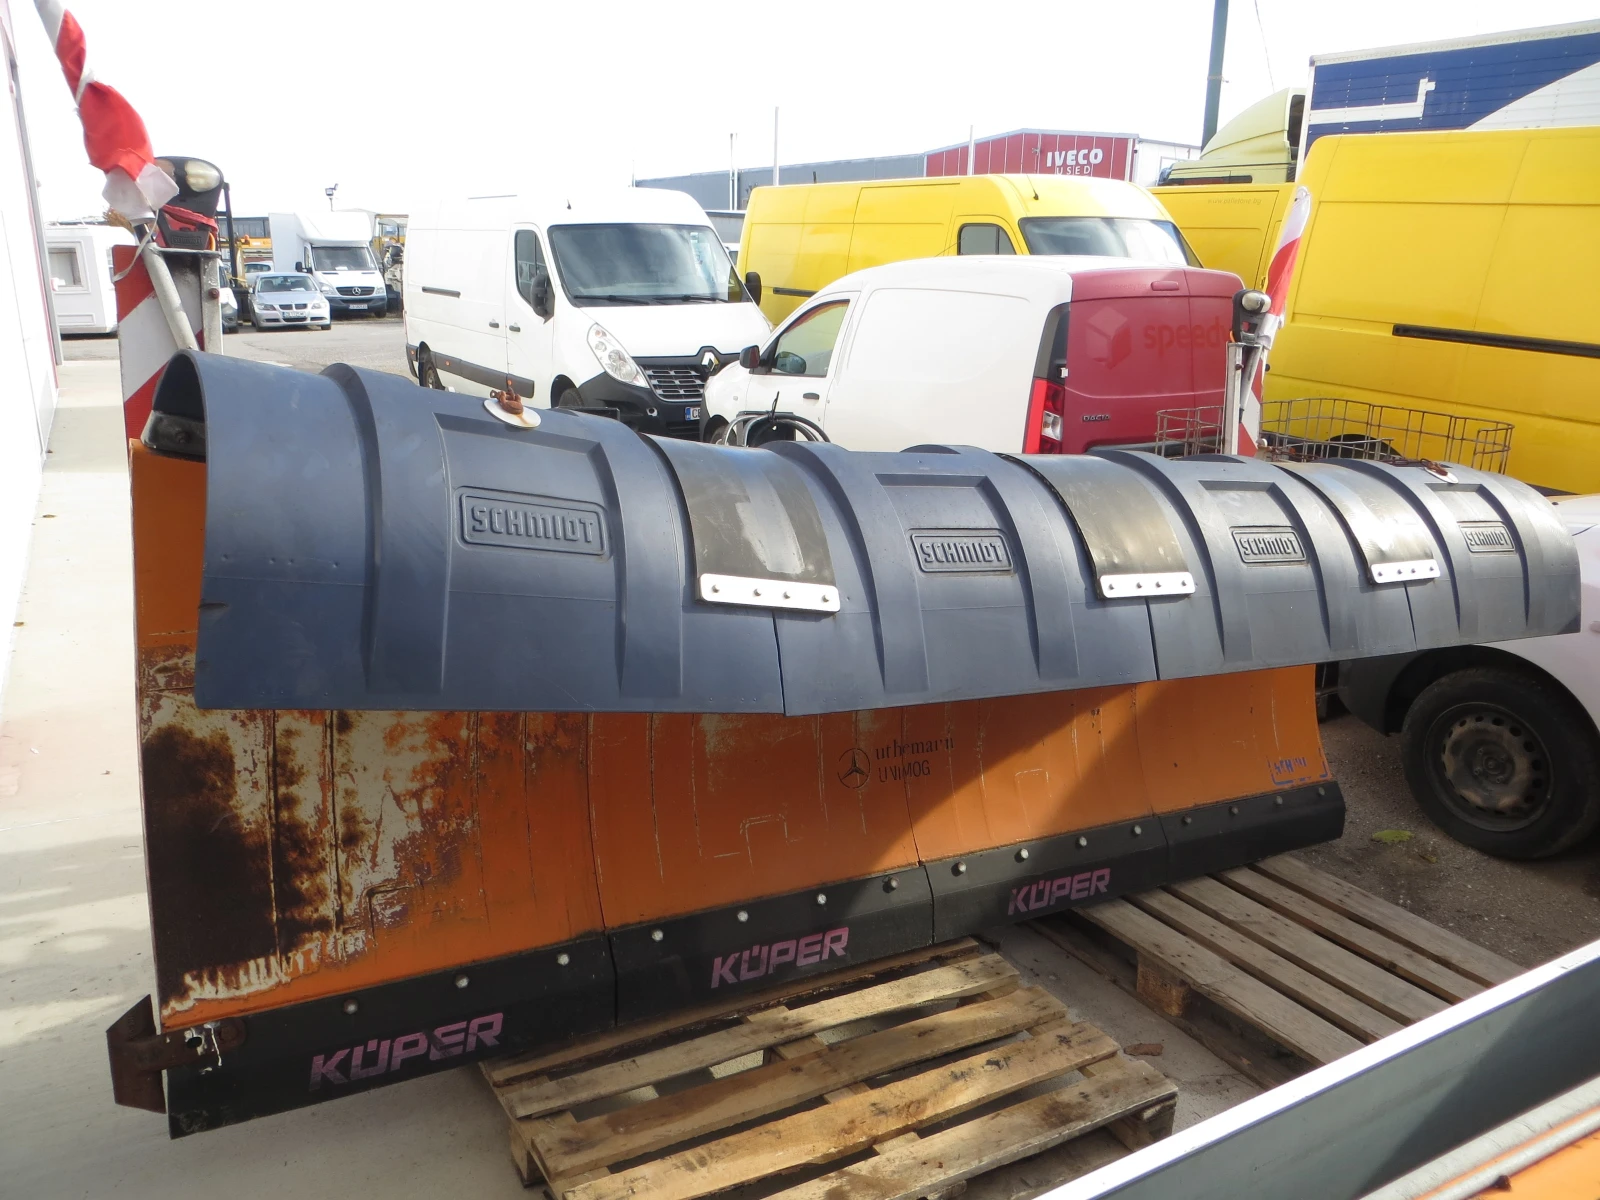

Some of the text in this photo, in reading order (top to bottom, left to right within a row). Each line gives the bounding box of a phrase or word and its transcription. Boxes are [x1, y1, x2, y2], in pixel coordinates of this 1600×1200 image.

[1046, 148, 1103, 167] IVECO
[1056, 165, 1091, 175] USED
[471, 504, 593, 543] SCHMIDT
[1240, 537, 1298, 556] SCHMIDT
[1464, 530, 1509, 546] SCHMIDT
[920, 541, 1003, 563] SCHMIDT
[878, 760, 931, 783] UNIMOG
[1007, 867, 1111, 916] KÜPER
[710, 926, 850, 989] KÜPER
[308, 1011, 504, 1092] KÜPER
